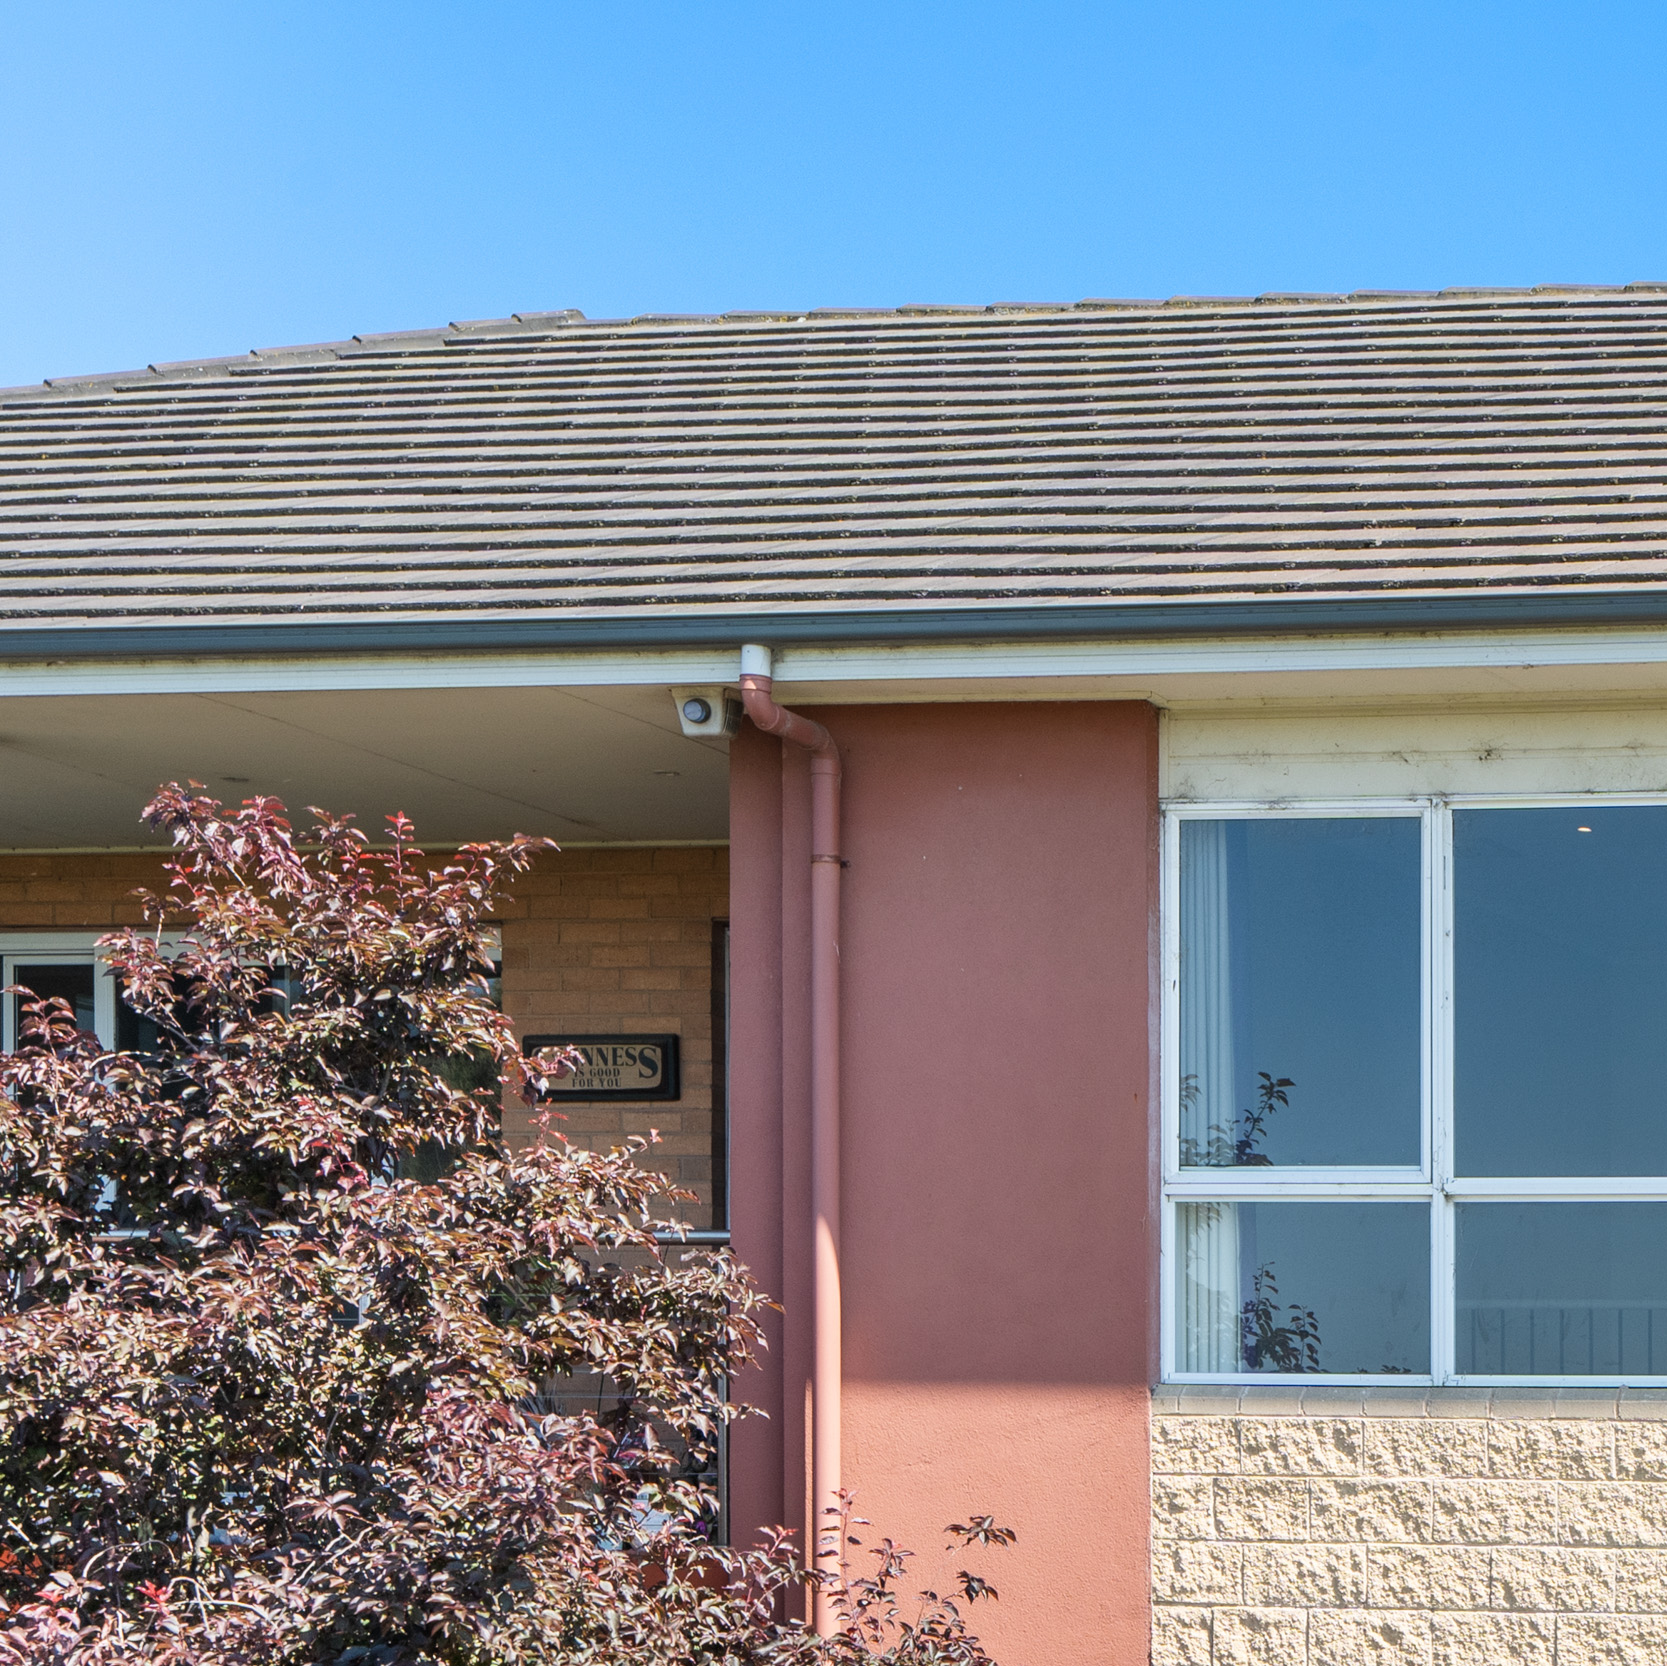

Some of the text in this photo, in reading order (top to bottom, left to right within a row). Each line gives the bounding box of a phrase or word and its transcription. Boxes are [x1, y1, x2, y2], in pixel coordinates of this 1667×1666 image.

[589, 1068, 620, 1078] GOOD
[572, 1078, 622, 1088] FOR YOU
